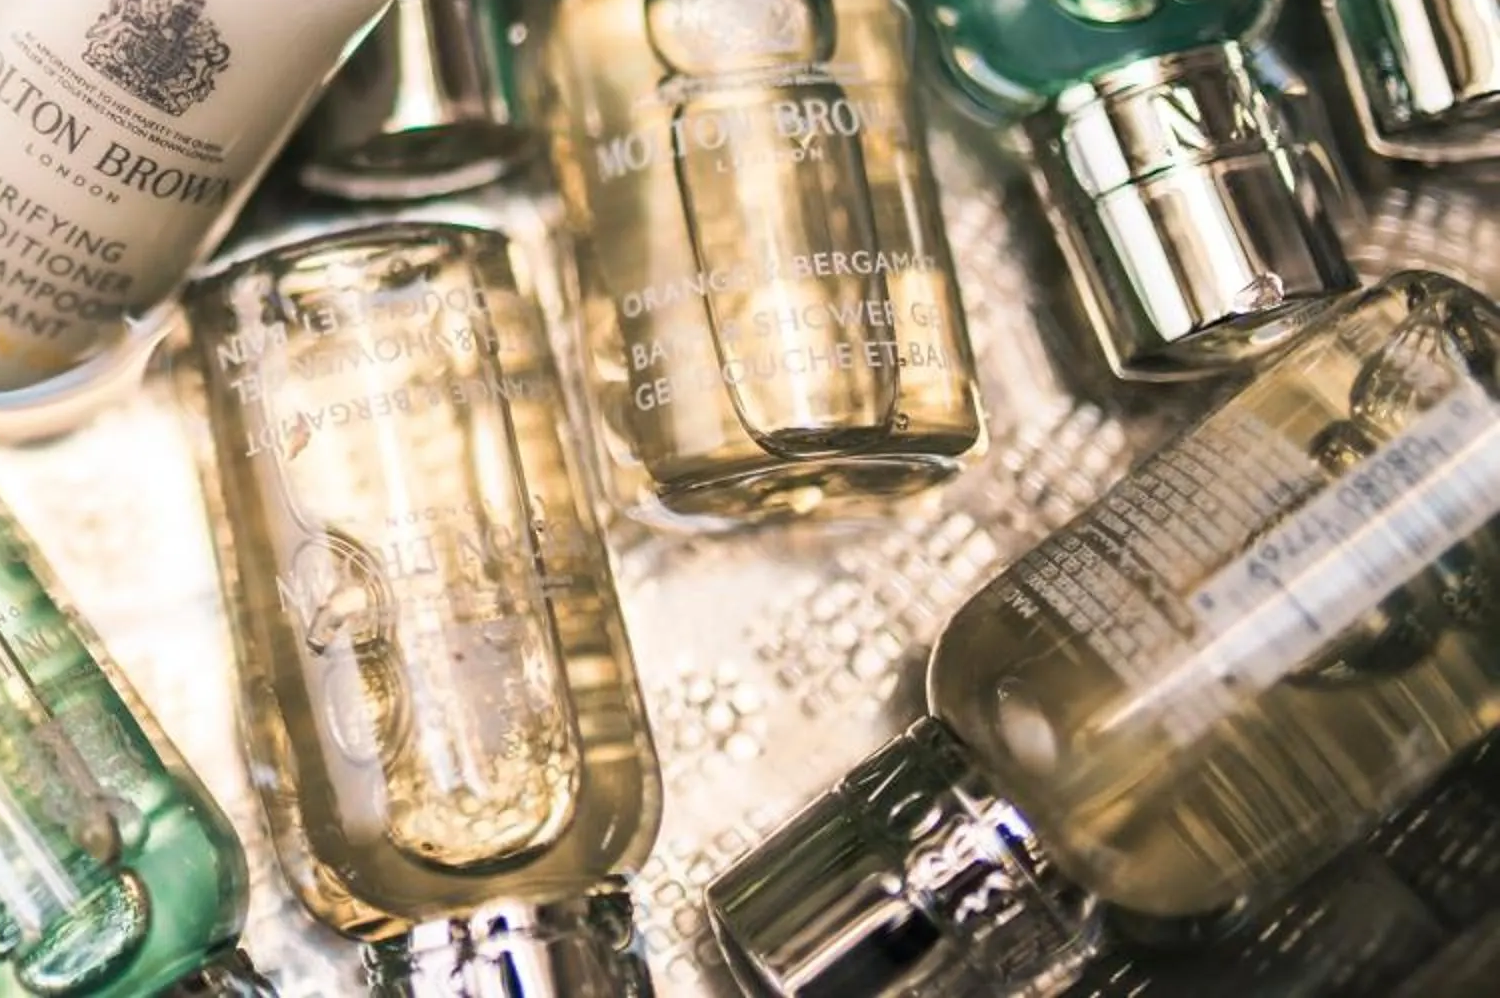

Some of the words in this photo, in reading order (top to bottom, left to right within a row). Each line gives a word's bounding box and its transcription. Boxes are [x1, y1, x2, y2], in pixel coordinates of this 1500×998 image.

[24, 142, 121, 205] LONDON
[752, 299, 899, 339] SHOWER
[453, 327, 474, 352] &
[863, 341, 898, 368] ET
